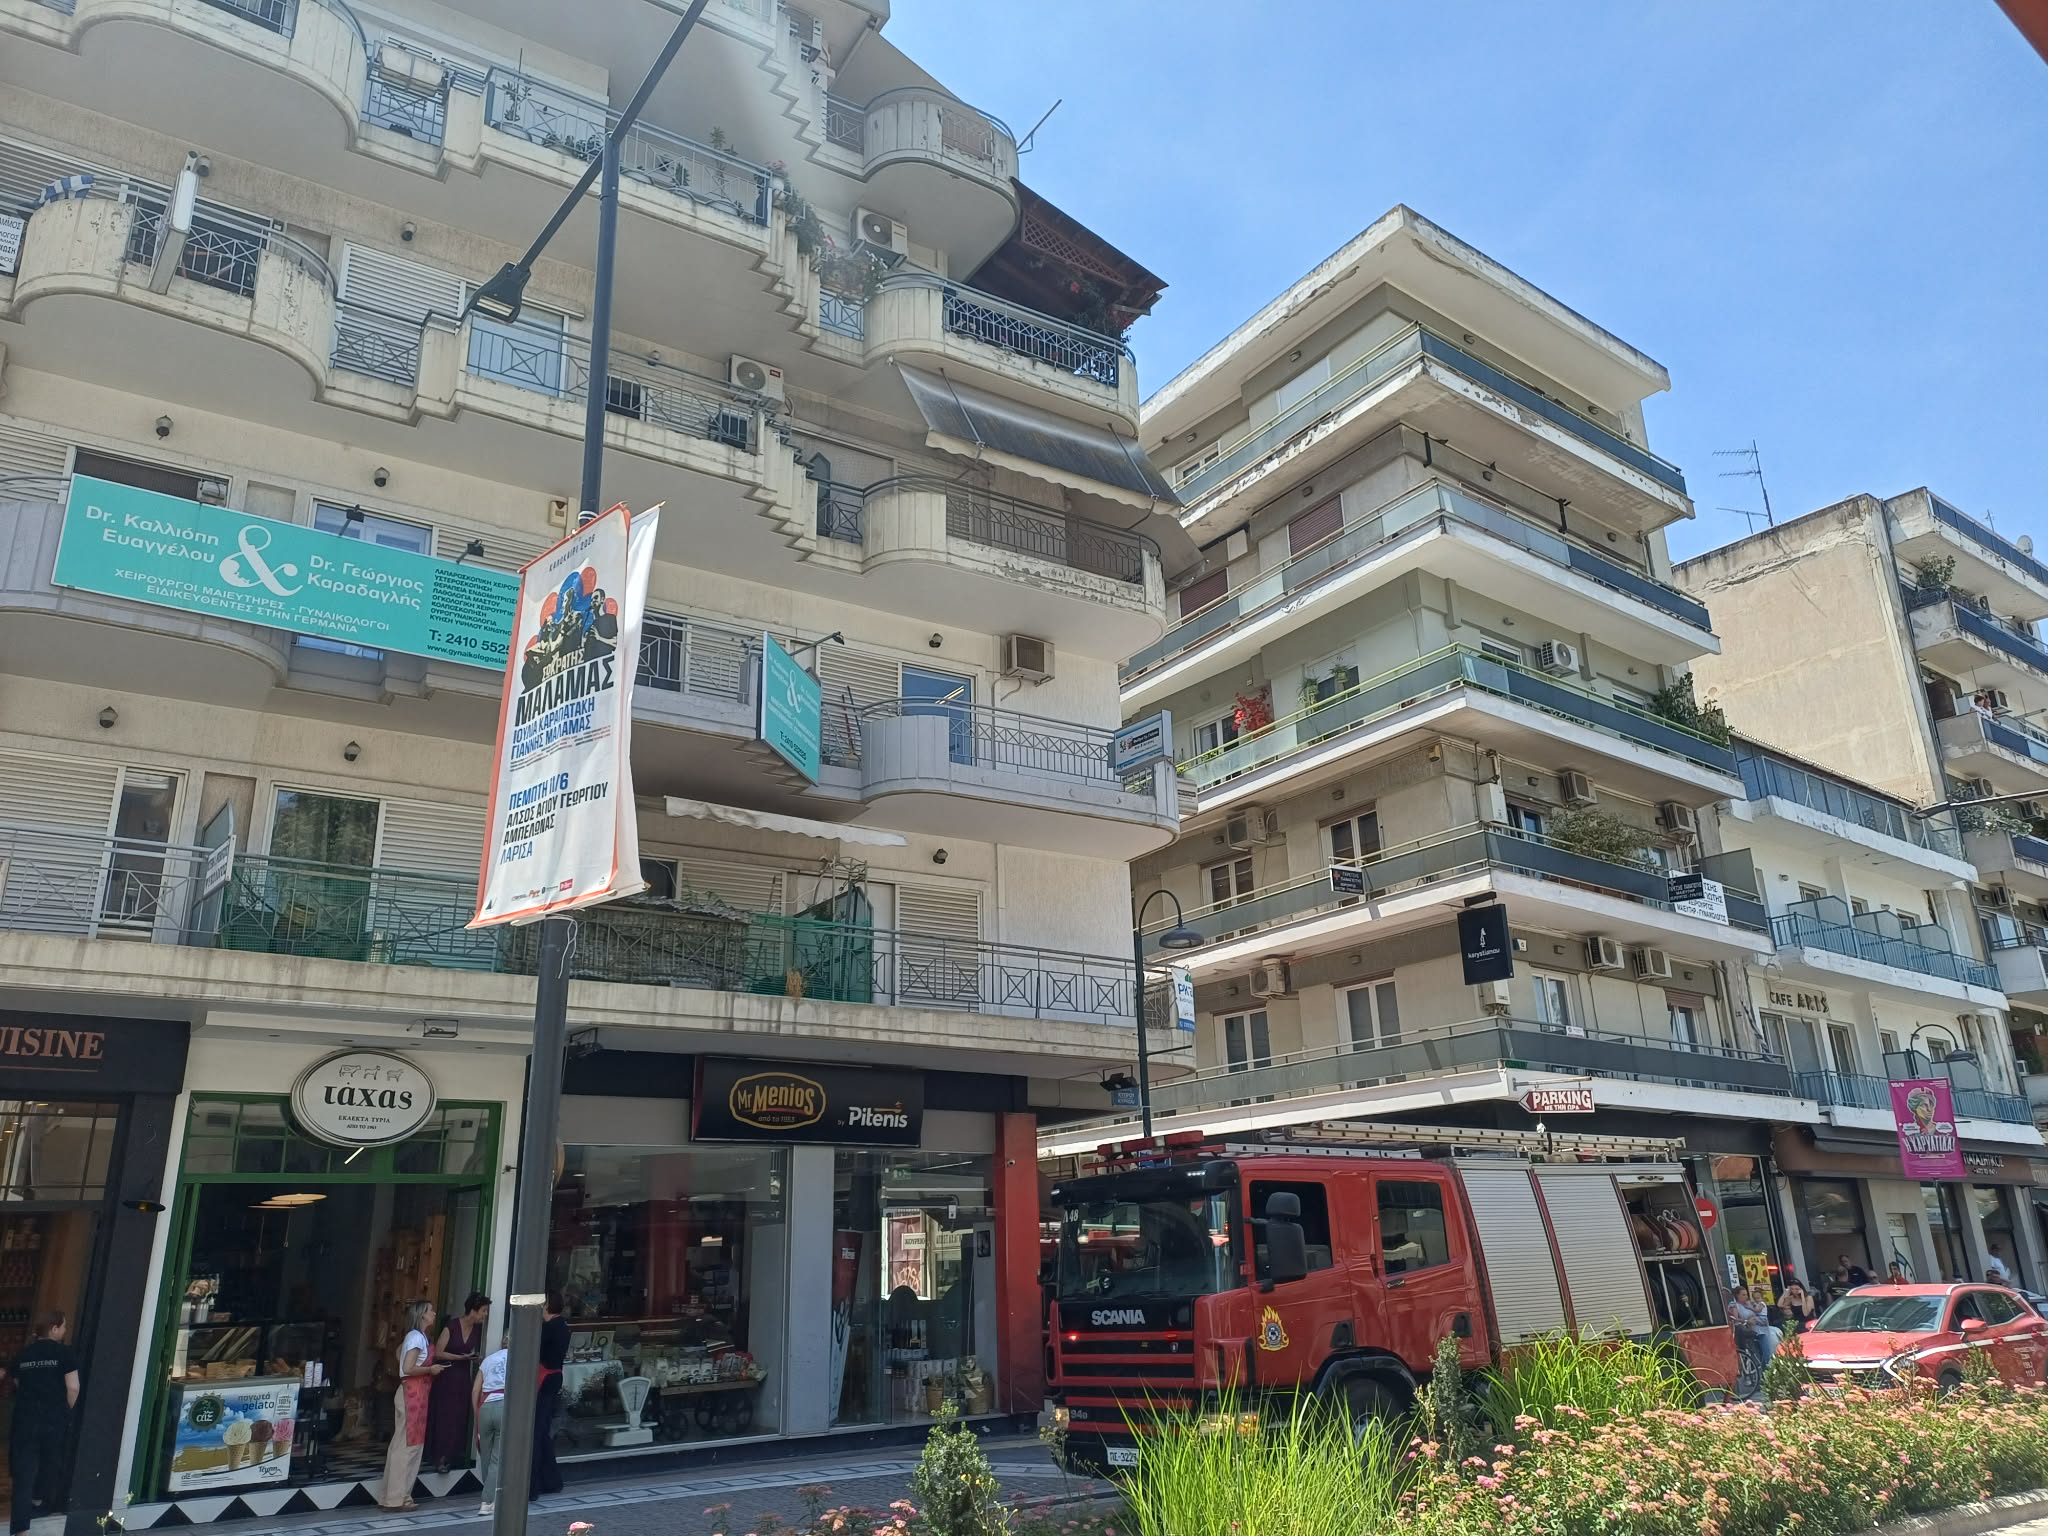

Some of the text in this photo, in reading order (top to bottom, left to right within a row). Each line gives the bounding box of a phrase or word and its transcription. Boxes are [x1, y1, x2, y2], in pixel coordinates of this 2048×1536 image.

[86, 504, 219, 546] Dr. Καλλιόπη
[102, 528, 215, 563] Ευαγγέλου
[310, 554, 424, 593] Dr. Γεώργιος
[434, 581, 467, 593] ΘΕΡΑΠΕΙΑ
[114, 568, 198, 592] ΧΕΙΡΟΥΡΓΟΙ
[203, 586, 285, 610] ΜΑΙΕΥΤΗΡΕΣ
[299, 606, 390, 630] ΓΥΝΑΙΚΟΛΟΓΟΙ
[307, 572, 422, 610] Καραδαγλής
[474, 597, 500, 607] ΜΑΣΤΟΥ
[146, 585, 358, 632] ΕΙΔΙΚΕΥΘΕΝΤΕΣ ΣΤΗΝ ΓΕΡΜΑΝΙΑ
[446, 633, 477, 648] 2410
[542, 648, 585, 680] ΣΩΚΡΑΤΗΣ
[515, 655, 615, 726] ΜΑΛΑΜΑΣ
[538, 696, 595, 730] ΚΑΡΑΠΑΤΑΚΗ
[511, 732, 543, 760] ΓΙΑΝΝΗΣ
[546, 714, 591, 744] ΜΑΛΑΜΑΣ
[509, 780, 548, 810] ΠΕΜΠΤΗ
[536, 795, 558, 818] ΑΓΙΟΥ
[560, 782, 608, 808] ΓΕΩΡΓΙΟΥ
[504, 814, 555, 846] ΑΜΠΕΛΩΝΑΣ
[500, 841, 533, 865] ΛΑΡΙΣΑ
[1770, 992, 1793, 1007] CAFE
[737, 1083, 814, 1116] Mr Menios
[1532, 1090, 1592, 1109] PARKING
[849, 1105, 908, 1128] Pitenis
[1092, 1310, 1146, 1326] SCANIA
[242, 1402, 274, 1412] gelato
